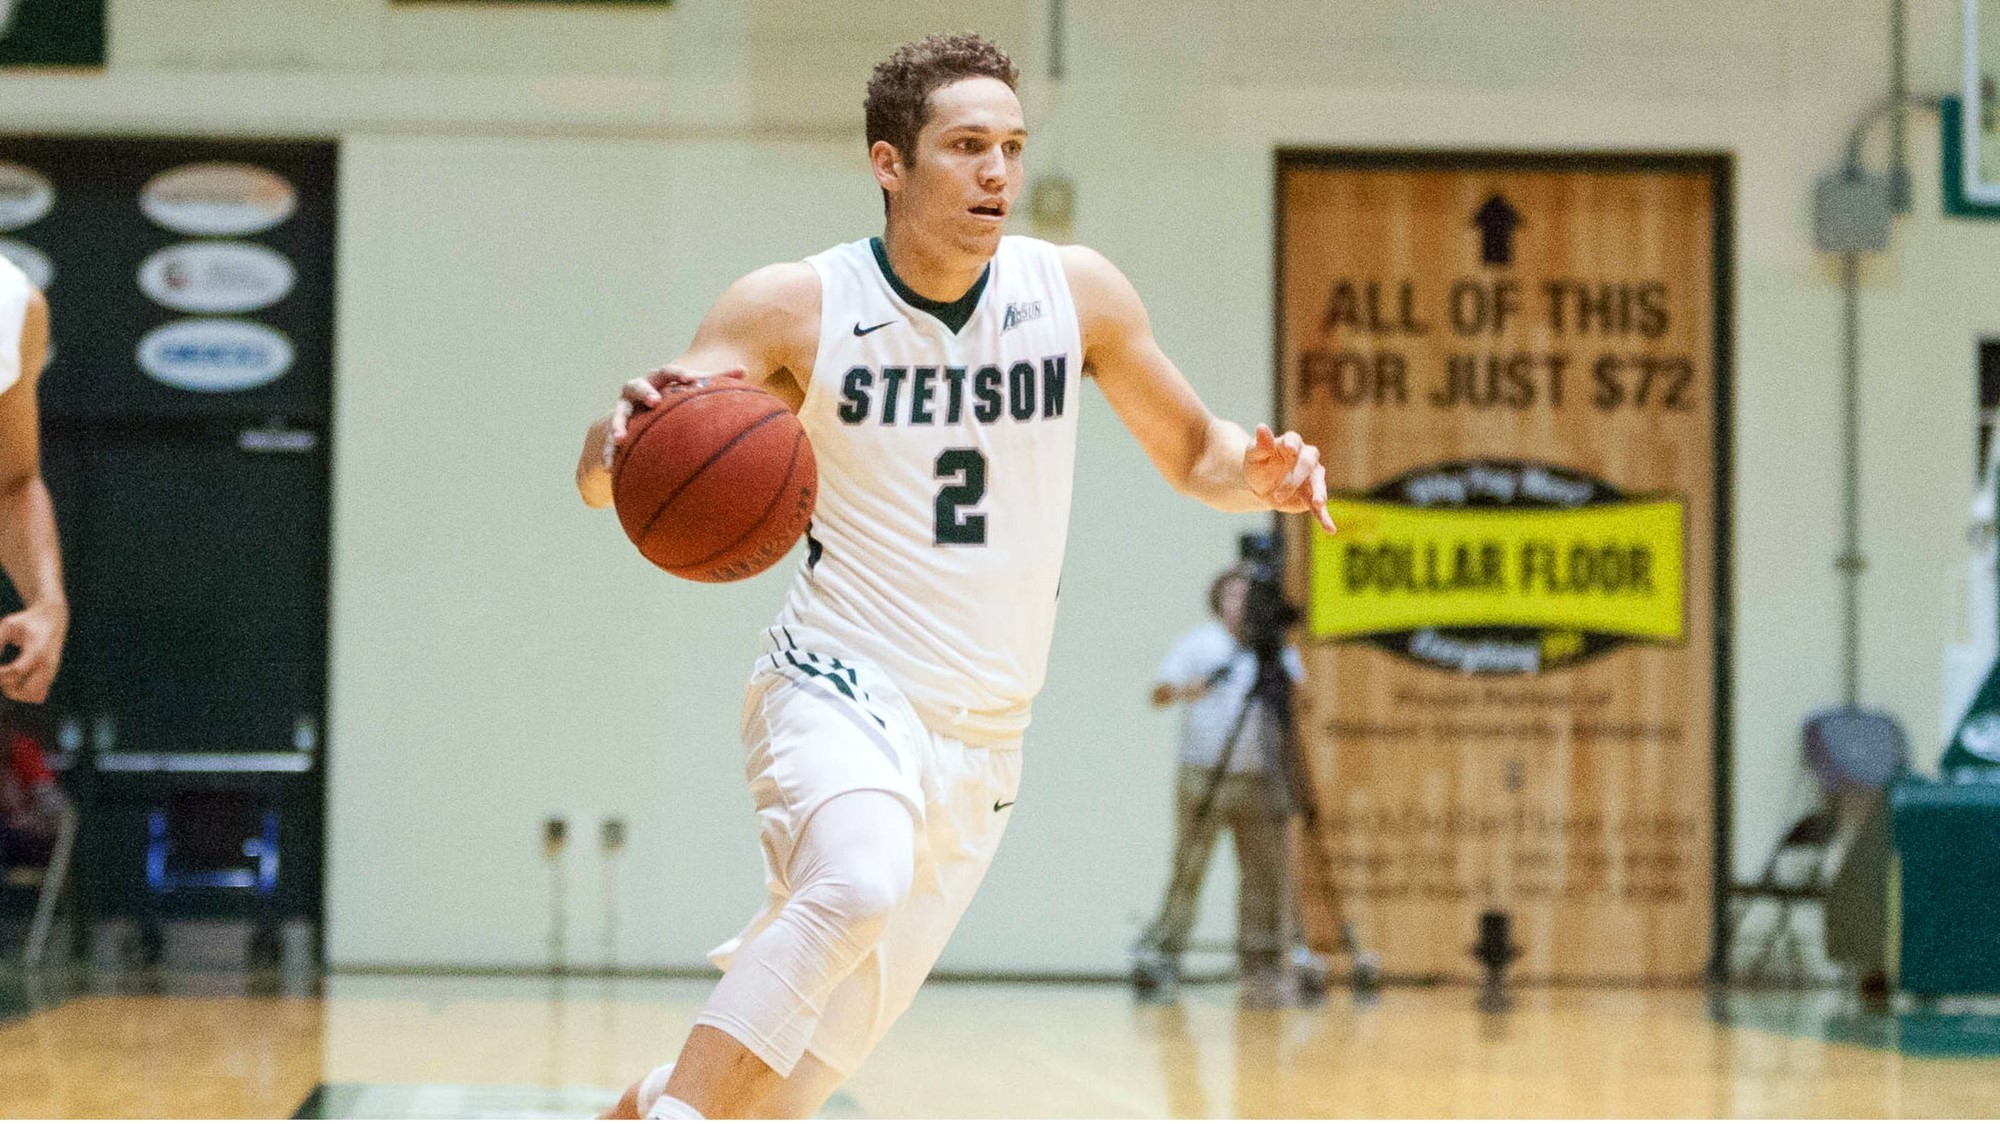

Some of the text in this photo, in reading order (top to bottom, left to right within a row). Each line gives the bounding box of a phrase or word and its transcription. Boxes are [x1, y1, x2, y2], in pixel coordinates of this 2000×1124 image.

[1326, 280, 1670, 338] ALL OF THIS
[838, 353, 1068, 426] STETSON
[1299, 351, 1695, 411] FOR JUST $72
[932, 447, 989, 547] 2
[1344, 542, 1657, 595] DOLLAR FLOOR
